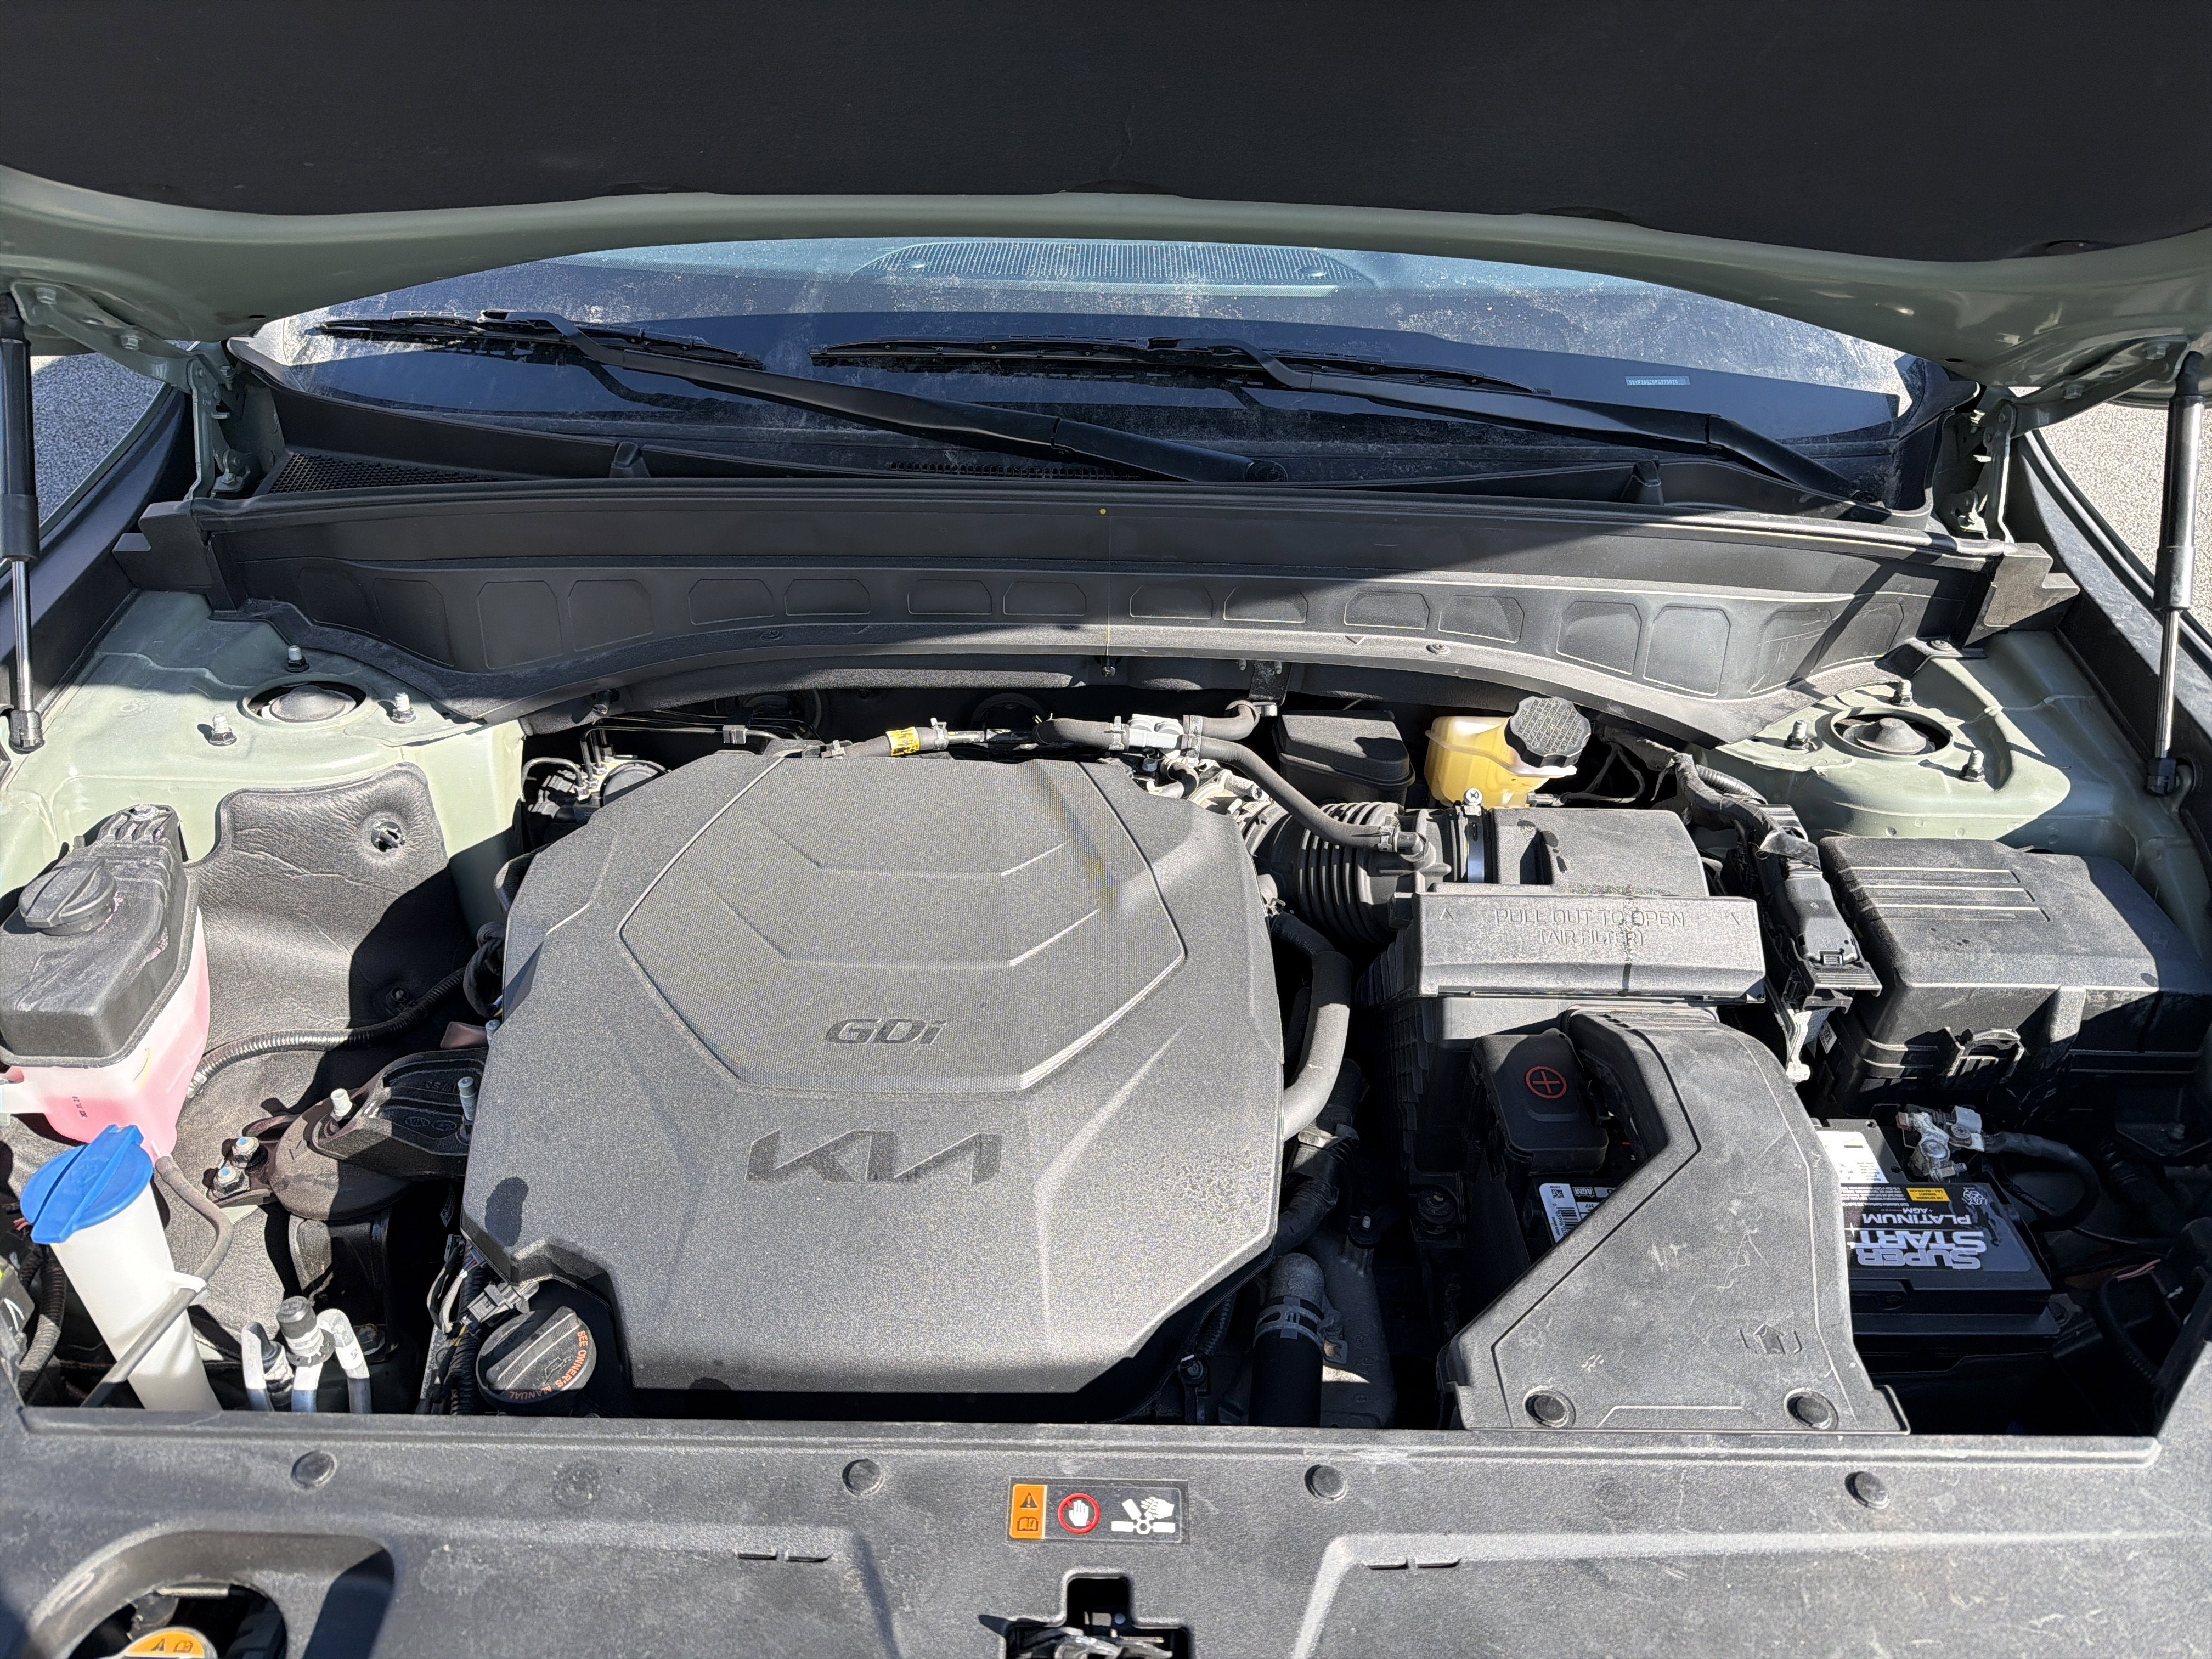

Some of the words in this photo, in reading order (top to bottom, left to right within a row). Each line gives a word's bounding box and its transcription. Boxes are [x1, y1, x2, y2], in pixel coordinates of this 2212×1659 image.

[1496, 909, 1546, 926] PULL
[1552, 909, 1593, 926] OUT
[1600, 910, 1625, 927] TO
[1631, 910, 1685, 927] OPEN
[1578, 930, 1644, 946] FILTER)
[825, 1018, 947, 1045] GDi
[744, 1128, 1002, 1187] KIA
[1574, 1187, 1593, 1195] AGM
[1861, 1213, 1972, 1225] PLATINUM
[1852, 1231, 1987, 1253] START
[1857, 1248, 1981, 1269] SUPER
[577, 1330, 588, 1347] SEE
[555, 1350, 587, 1388] OWNER'S
[510, 1385, 552, 1399] MANUAL
